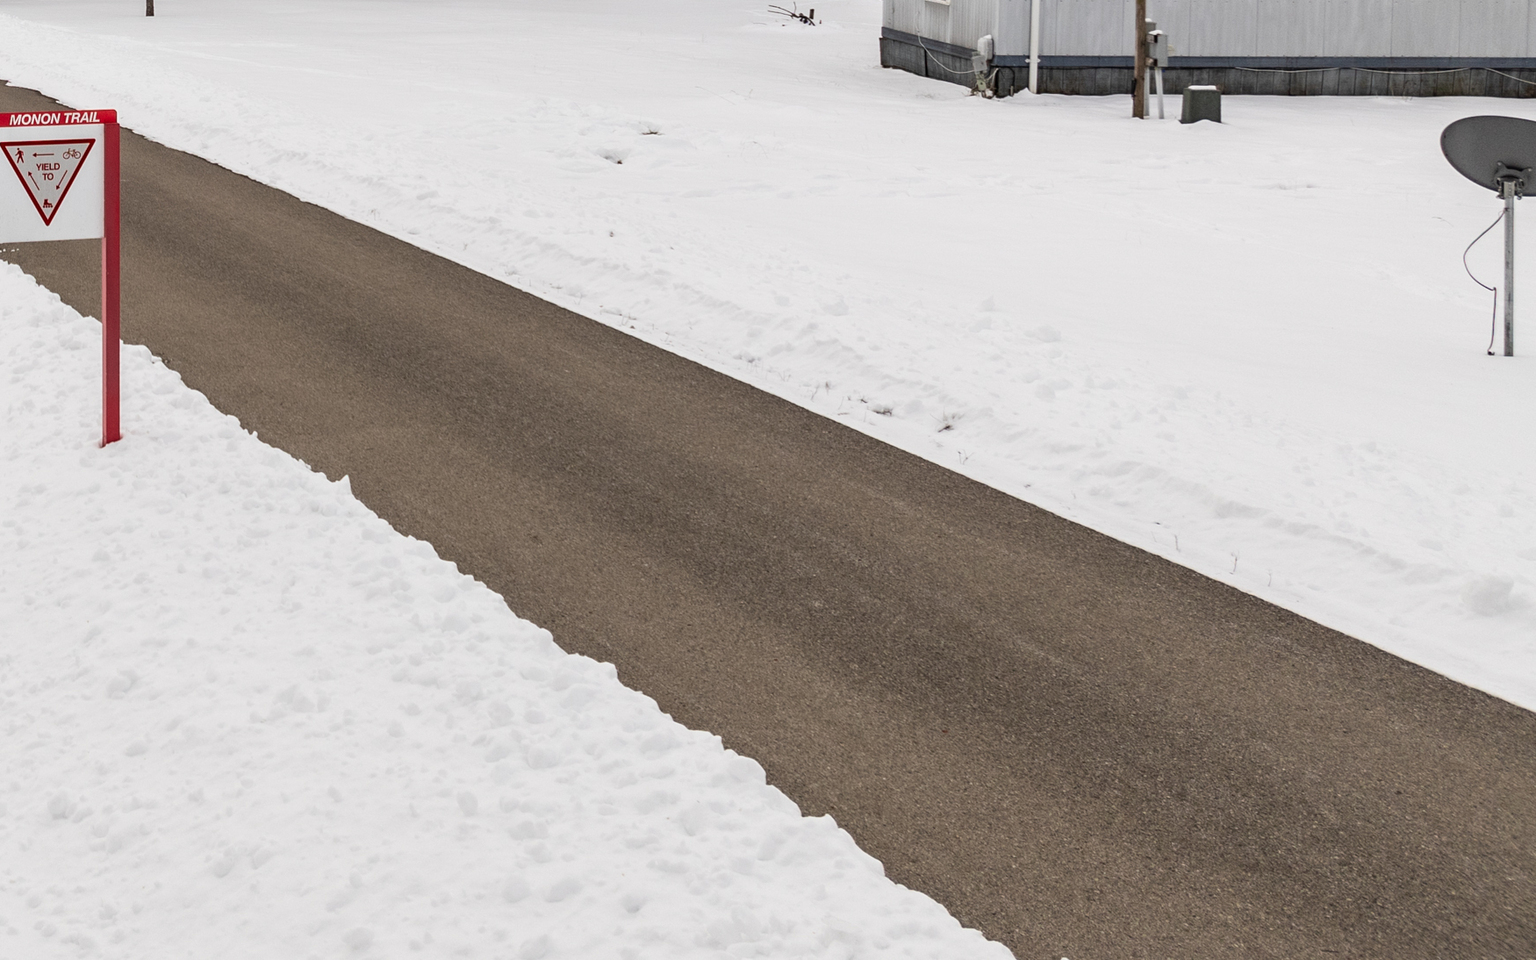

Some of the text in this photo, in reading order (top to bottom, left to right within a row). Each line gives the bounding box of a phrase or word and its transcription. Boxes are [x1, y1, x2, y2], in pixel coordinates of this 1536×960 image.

[9, 112, 100, 126] MONON TRAIL
[36, 163, 60, 171] YIELD
[42, 172, 54, 181] TO
